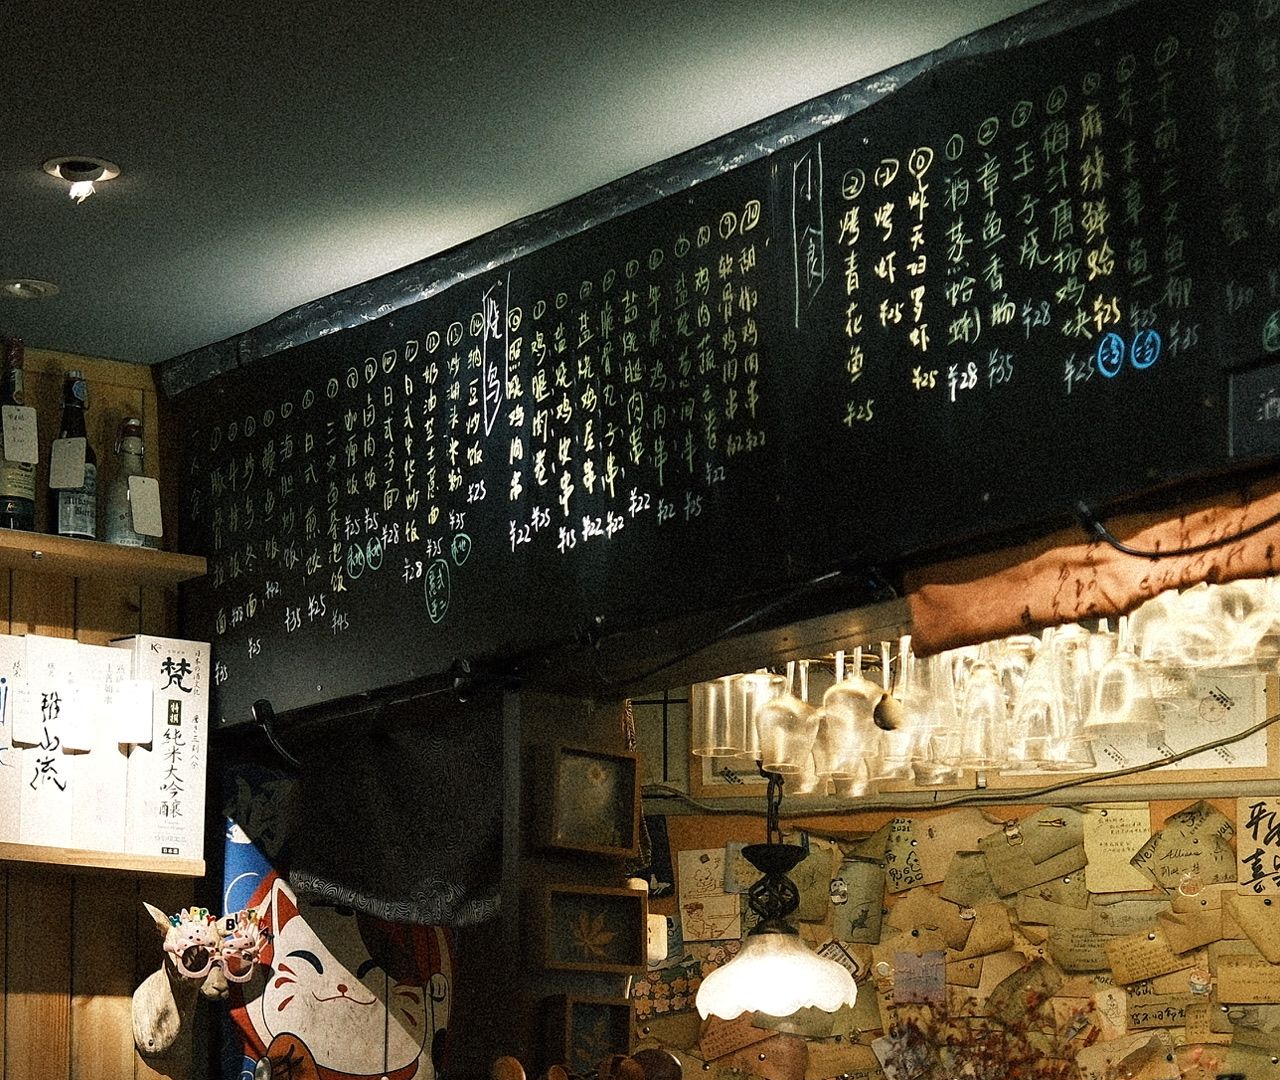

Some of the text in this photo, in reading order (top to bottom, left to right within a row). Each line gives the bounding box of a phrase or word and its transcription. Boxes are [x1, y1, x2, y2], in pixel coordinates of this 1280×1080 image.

[1012, 141, 1051, 270] 玉子烧
[874, 202, 897, 284] 烤虾
[976, 152, 1016, 327] 章鱼香肠
[838, 206, 874, 427] 烤青花鱼 ¥25
[1022, 299, 1051, 339] ¥28
[1093, 293, 1121, 333] ¥25
[911, 365, 938, 391] ¥25
[947, 361, 978, 402] ¥28
[465, 350, 483, 466] 纳豆炒饭
[344, 408, 360, 496] 咖喱饭
[628, 487, 651, 518] ¥22
[508, 520, 532, 552] ¥22
[160, 656, 194, 693] 梵
[159, 728, 186, 818] 純米大吟醸
[169, 906, 217, 928] HAPPY
